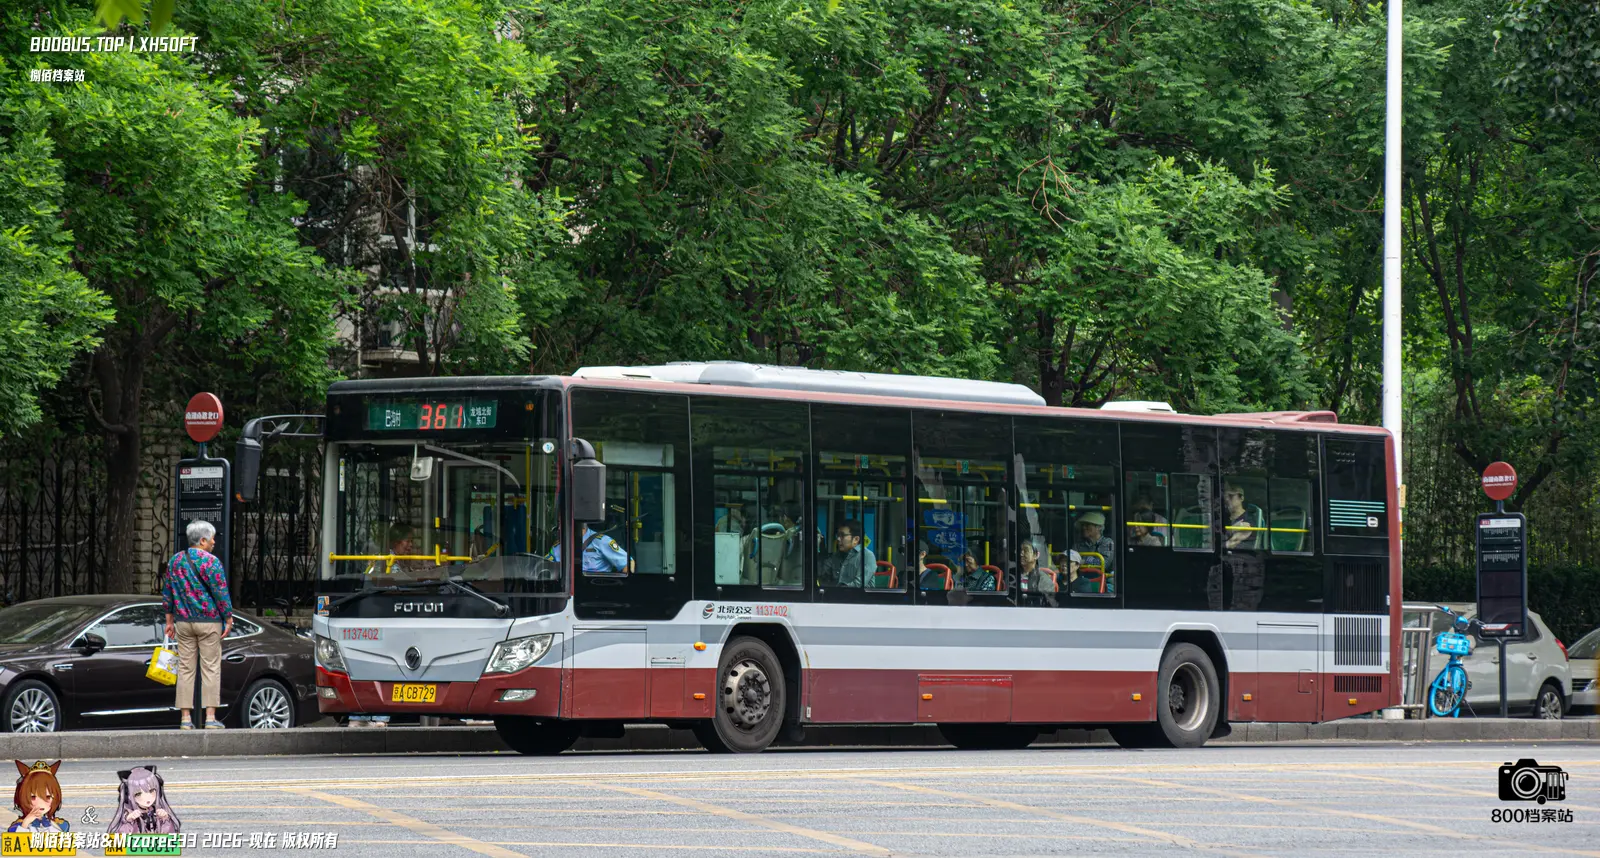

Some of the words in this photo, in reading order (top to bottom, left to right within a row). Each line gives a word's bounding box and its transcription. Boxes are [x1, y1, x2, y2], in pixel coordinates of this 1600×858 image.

[419, 404, 463, 430] 361
[394, 602, 444, 613] FOTON
[717, 605, 752, 614] 北京公交
[756, 605, 788, 617] 1137402
[342, 628, 379, 641] 1137402
